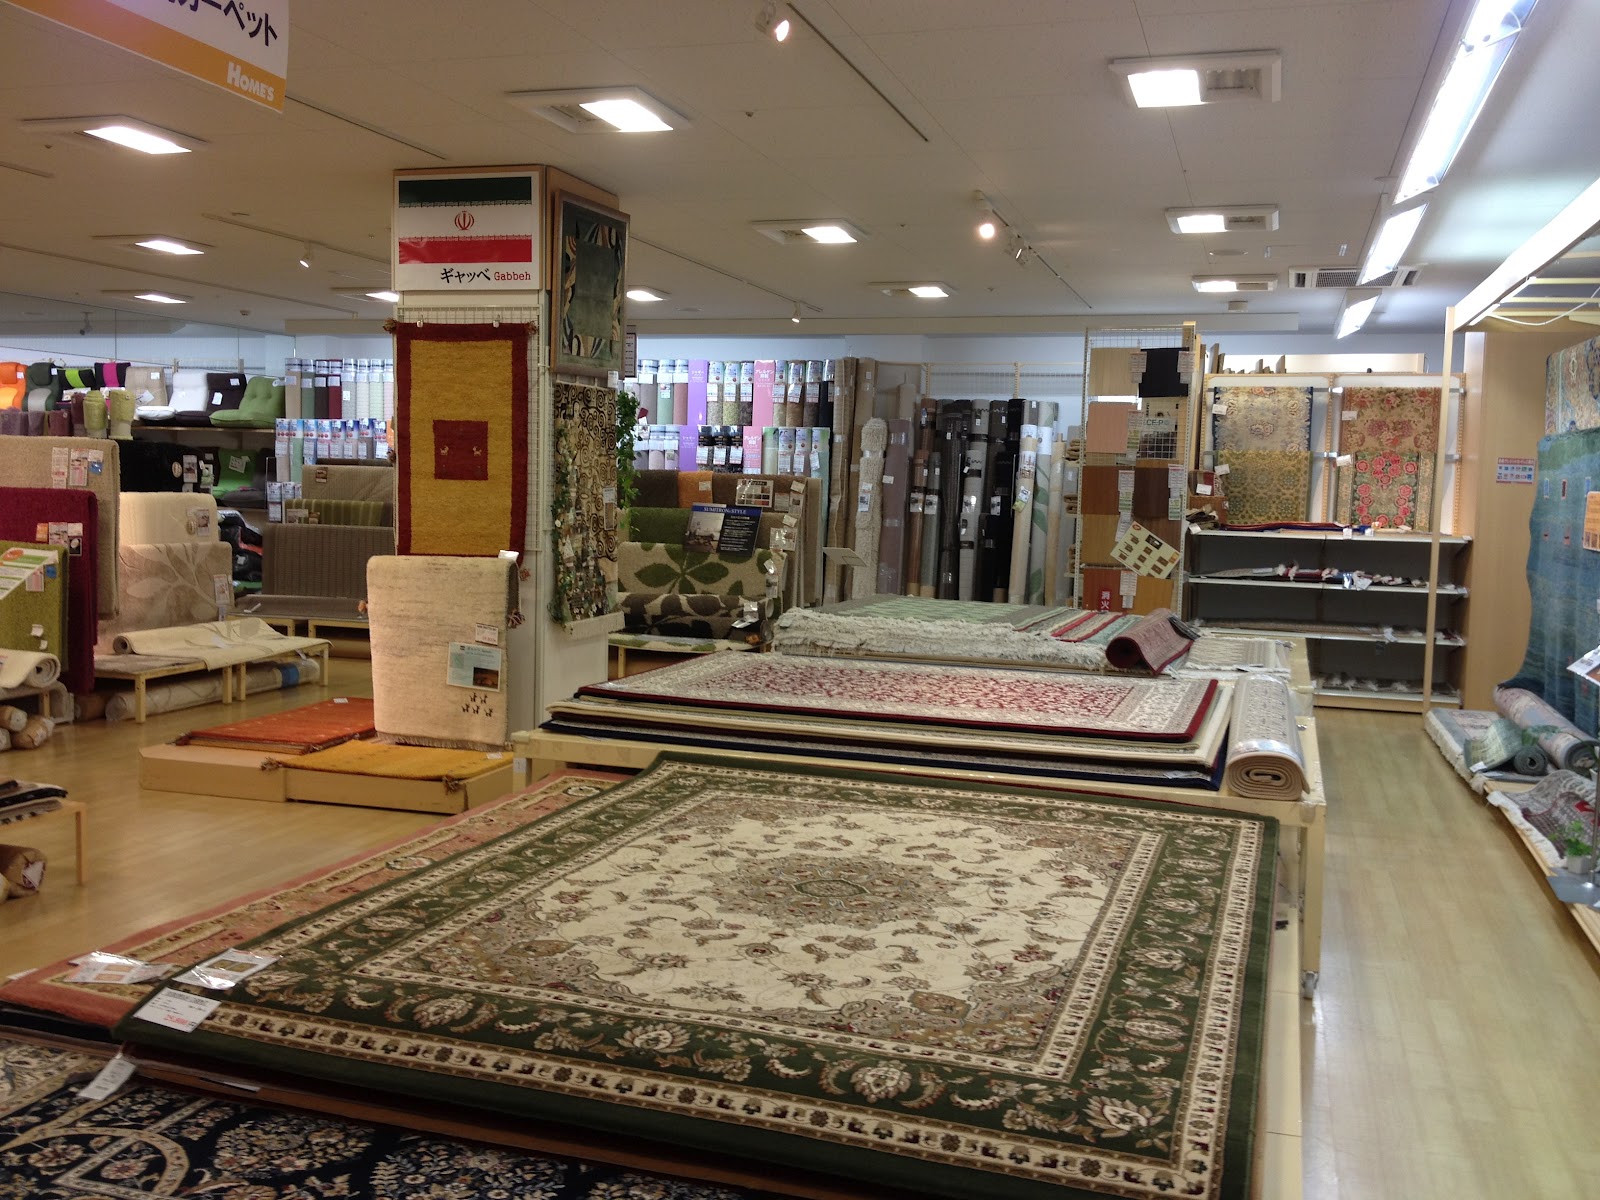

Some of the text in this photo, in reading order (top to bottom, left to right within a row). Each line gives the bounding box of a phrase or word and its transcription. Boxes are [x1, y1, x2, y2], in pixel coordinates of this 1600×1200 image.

[440, 267, 531, 284] ギャッベ Gabbeh
[1100, 590, 1111, 613] 消火
